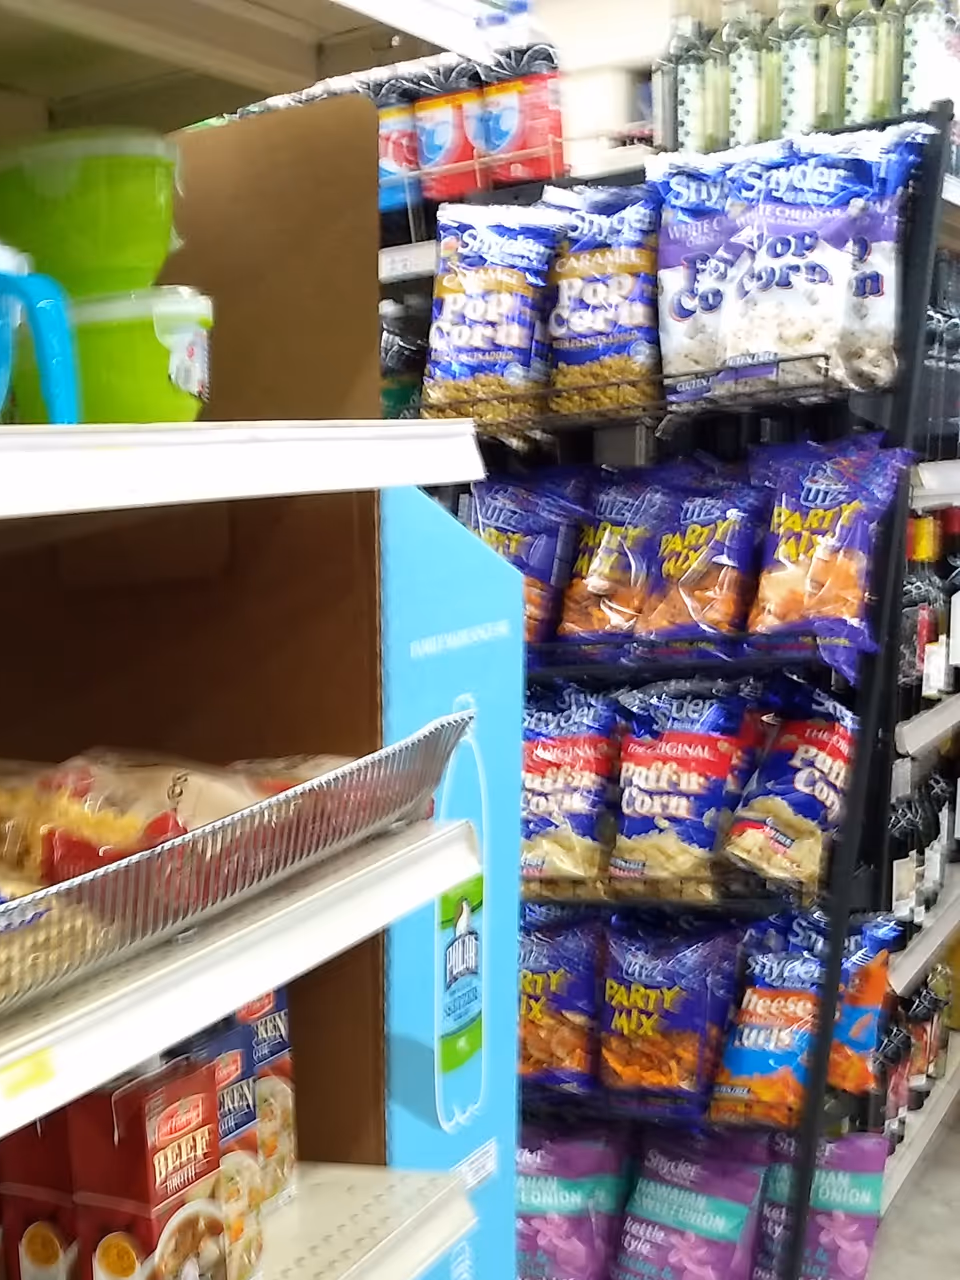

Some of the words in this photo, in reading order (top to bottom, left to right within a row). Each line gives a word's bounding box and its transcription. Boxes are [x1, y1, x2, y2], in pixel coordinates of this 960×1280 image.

[771, 500, 862, 534] PARTY
[660, 518, 740, 556] PARTY
[621, 786, 690, 819] Corn
[446, 935, 476, 982] POLAR
[521, 968, 569, 995] RTY
[605, 977, 686, 1010] PARTY
[520, 994, 547, 1023] IX
[611, 1008, 660, 1036] MIX
[153, 1127, 211, 1187] BEEF
[167, 1164, 197, 1195] BROTH
[818, 1187, 872, 1206] ONION
[623, 1217, 666, 1241] kettle
